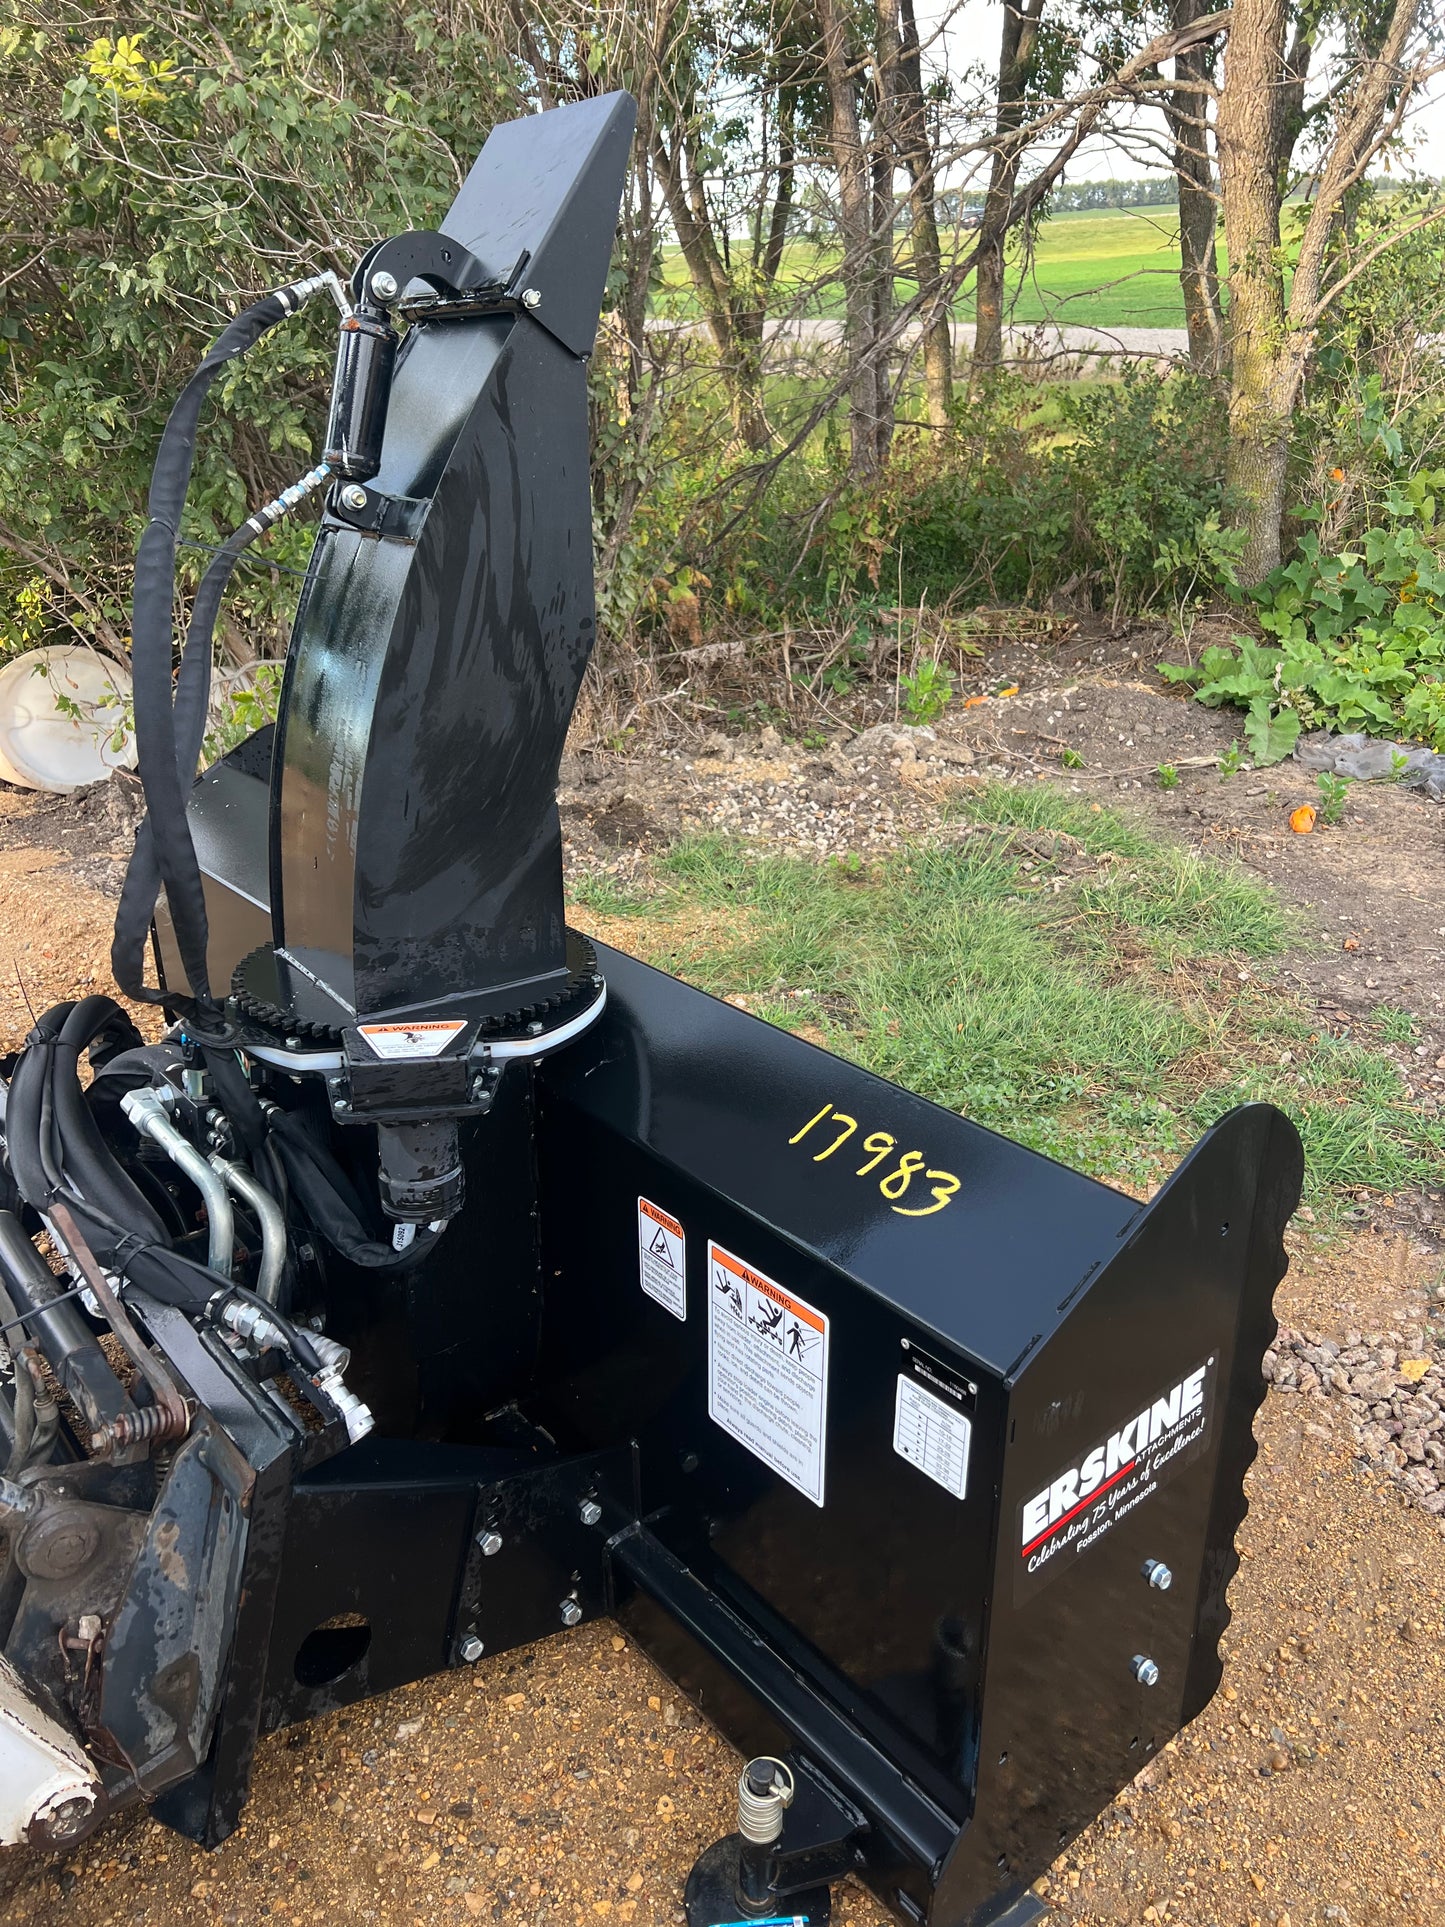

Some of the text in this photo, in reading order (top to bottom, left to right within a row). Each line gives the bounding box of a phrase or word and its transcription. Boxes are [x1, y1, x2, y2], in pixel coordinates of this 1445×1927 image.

[392, 1023, 450, 1032] WARNING
[788, 1103, 961, 1216] 17983
[650, 1205, 681, 1235] WARNING
[751, 1278, 792, 1309] WARNING
[1022, 1365, 1206, 1546] ERSKINE
[1134, 1406, 1202, 1466] ATTACHMENTS
[1027, 1417, 1205, 1573] Celebrating 75 Years of Excellence!
[1076, 1481, 1157, 1553] Fosston, Minnesota
